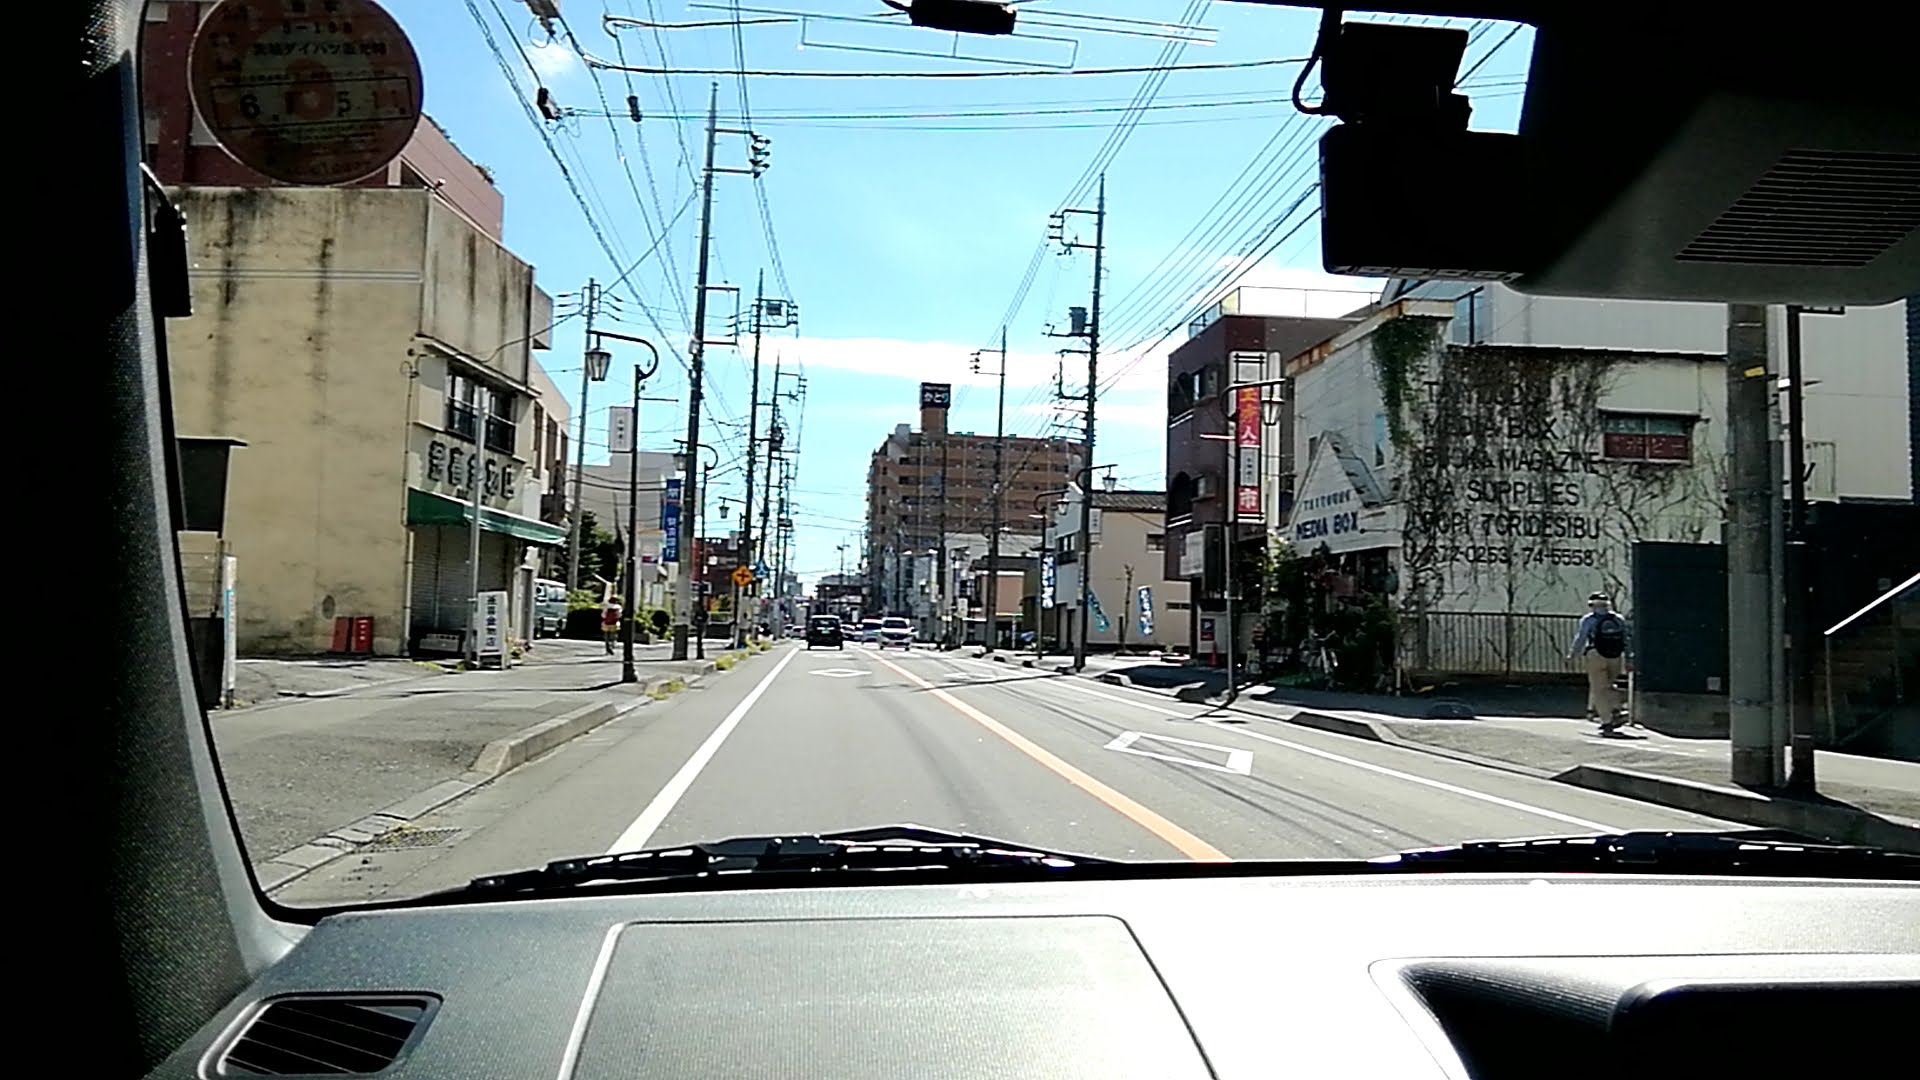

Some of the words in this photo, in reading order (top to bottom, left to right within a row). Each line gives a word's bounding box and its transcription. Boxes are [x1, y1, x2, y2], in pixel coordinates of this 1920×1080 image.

[1507, 416, 1560, 440] BOX
[1466, 480, 1580, 506] SUPPLIES
[1295, 516, 1329, 541] MEDIA
[1333, 511, 1359, 535] BOX
[1481, 511, 1601, 540] TORIDESIBU
